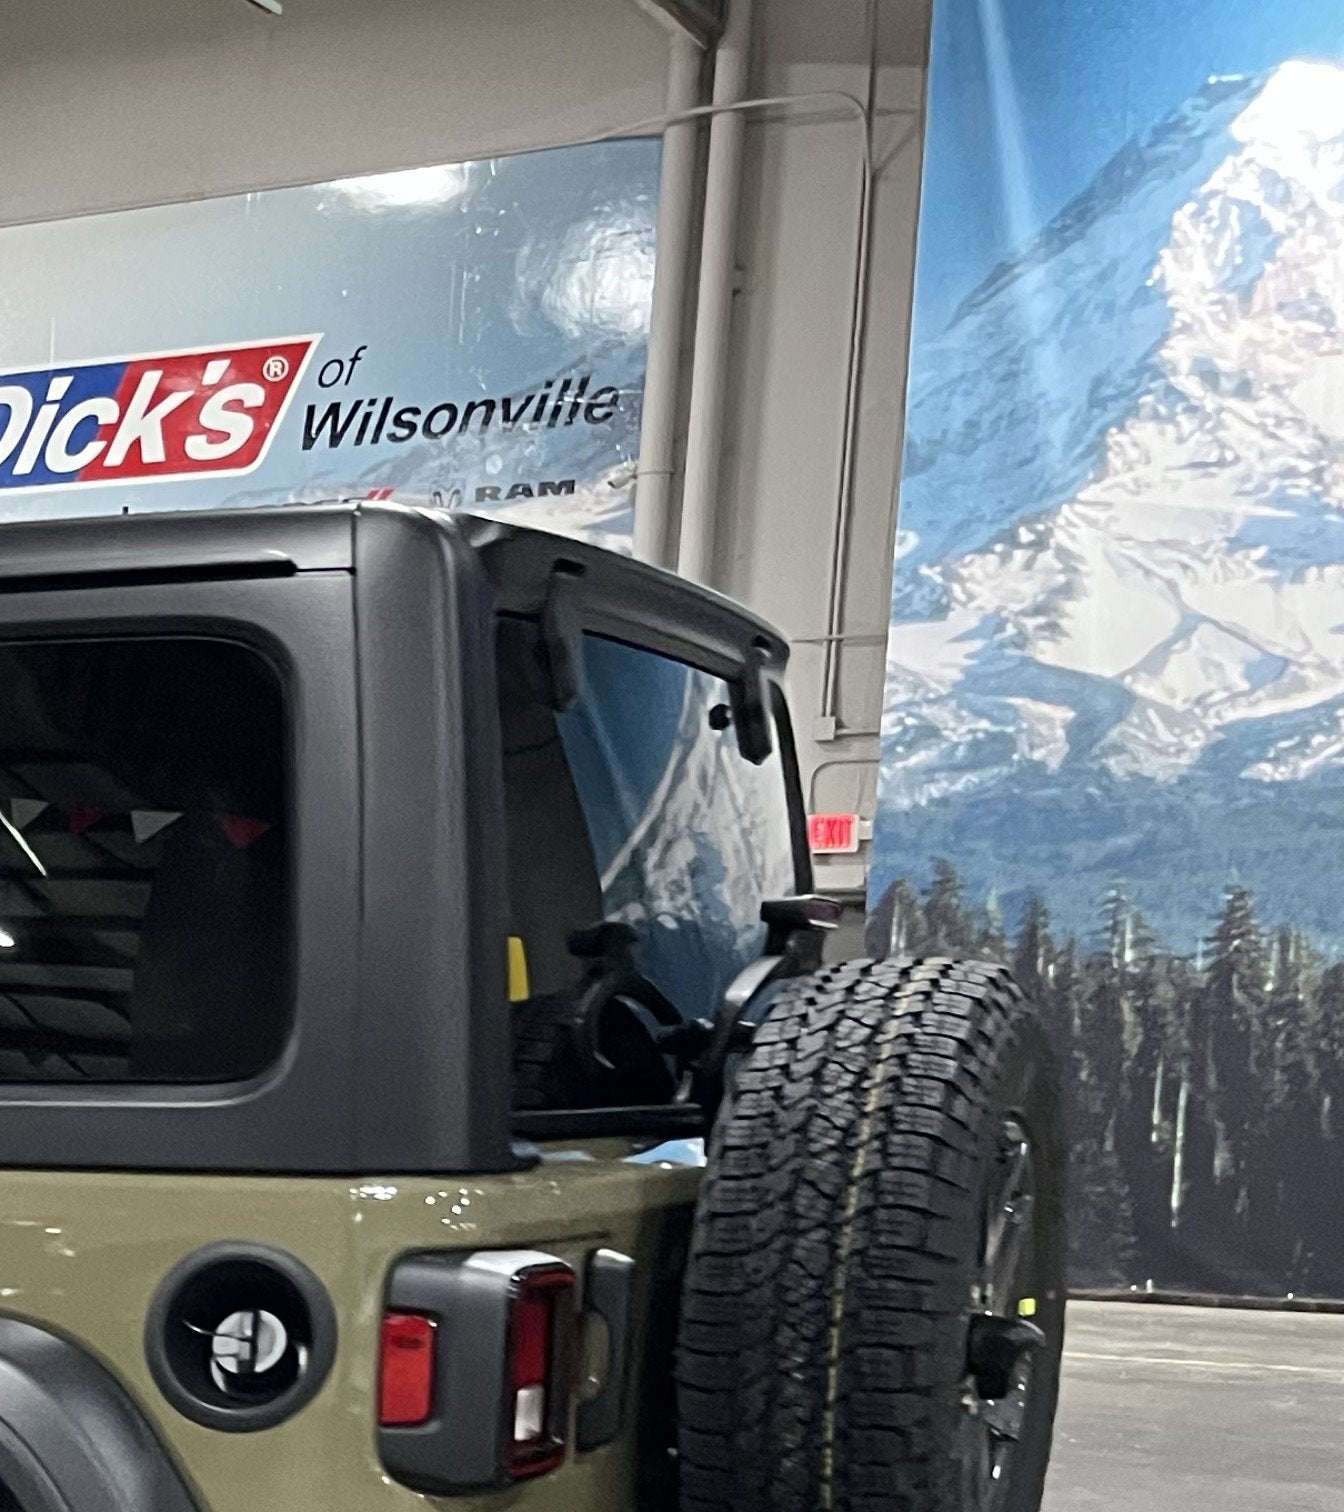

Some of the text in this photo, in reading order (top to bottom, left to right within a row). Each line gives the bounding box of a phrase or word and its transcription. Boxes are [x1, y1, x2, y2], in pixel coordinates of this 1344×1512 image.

[317, 345, 368, 388] of
[301, 376, 619, 451] Wilsonville
[475, 479, 575, 503] RAM
[811, 816, 853, 848] EXIT
